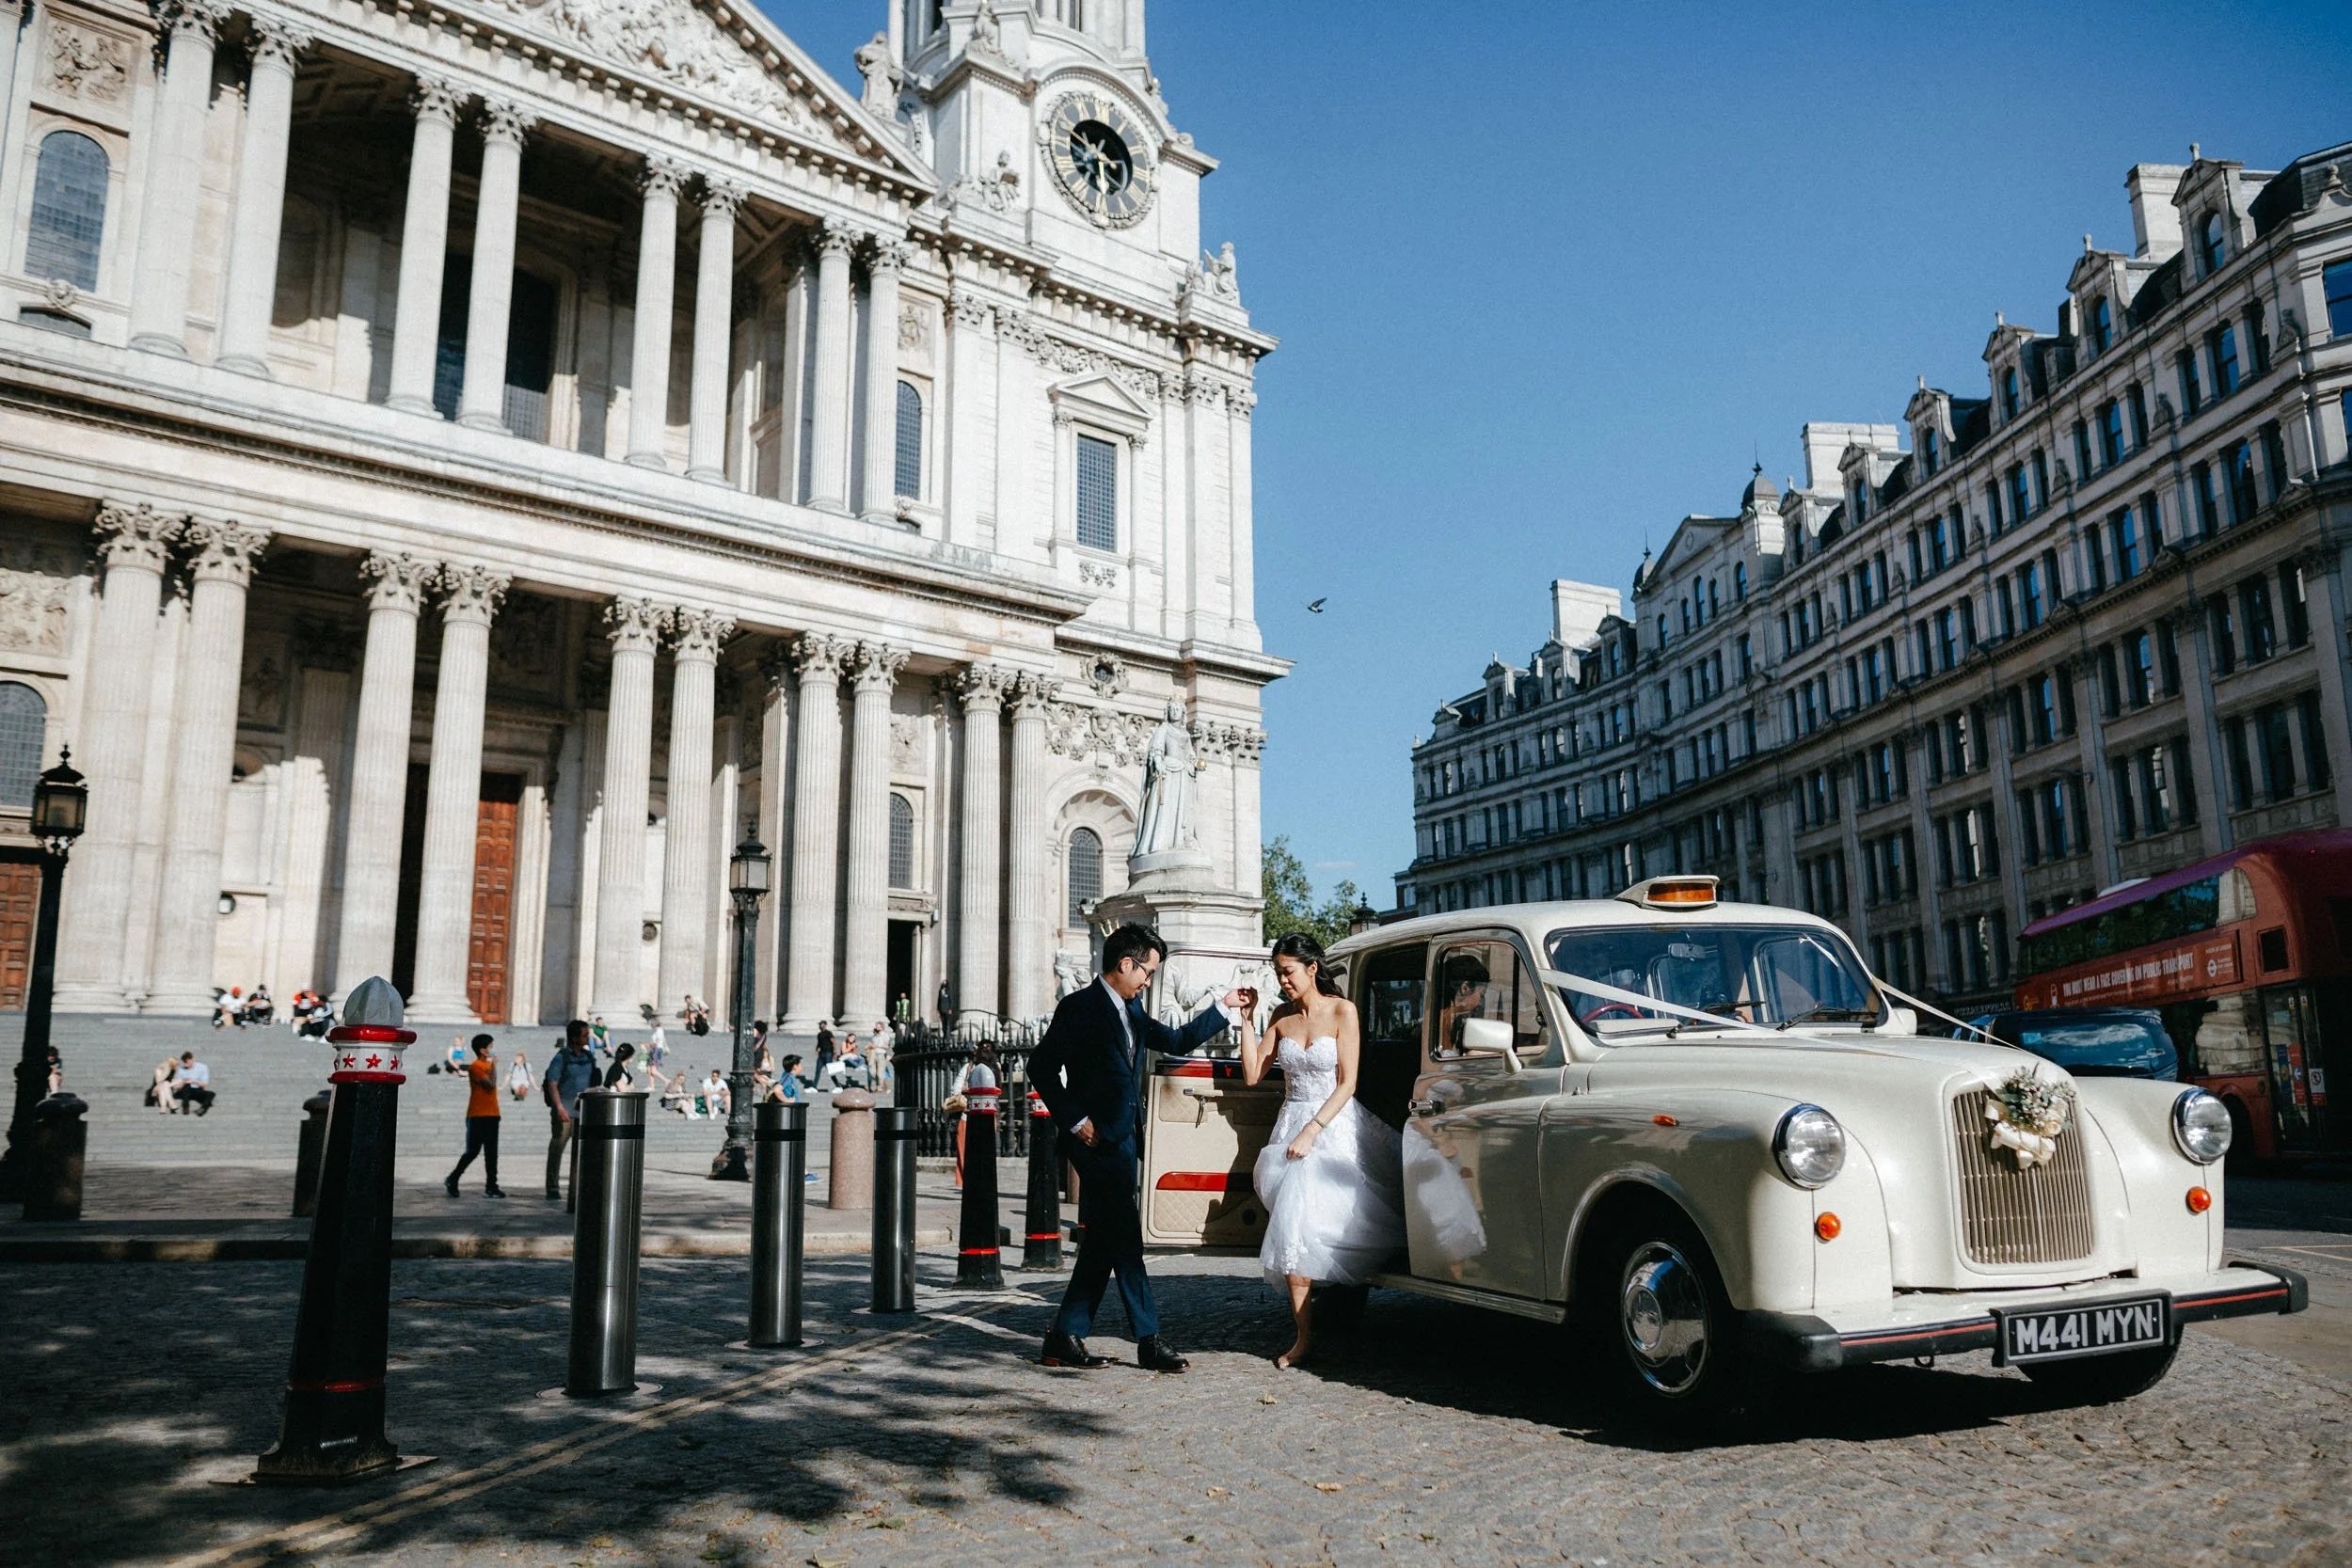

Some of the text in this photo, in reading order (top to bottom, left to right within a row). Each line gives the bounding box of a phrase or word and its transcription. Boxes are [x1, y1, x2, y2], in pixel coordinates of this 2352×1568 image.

[2083, 975, 2095, 991] WEAR
[2100, 973, 2111, 988] FACE
[2135, 964, 2142, 981] ON
[2142, 960, 2162, 979] PUBLIC
[2162, 952, 2194, 975] TRANSPORT
[2016, 1305, 2153, 1354] M441 MYN
